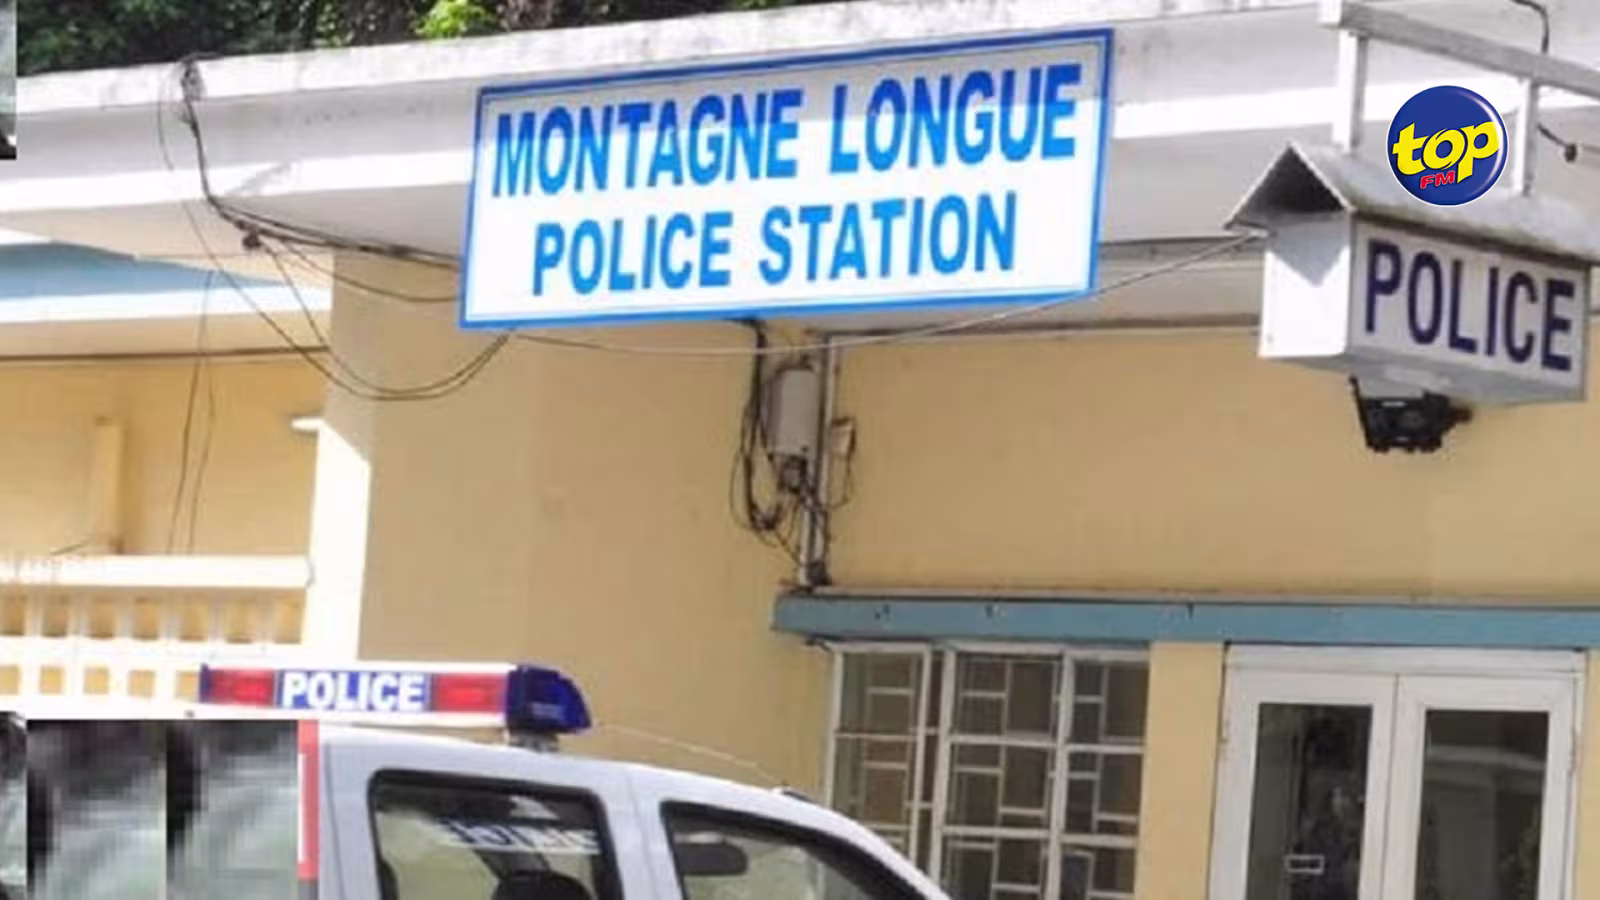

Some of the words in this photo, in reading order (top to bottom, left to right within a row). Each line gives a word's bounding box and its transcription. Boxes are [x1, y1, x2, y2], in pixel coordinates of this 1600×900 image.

[493, 89, 803, 197] MONTAGNE
[830, 64, 1081, 172] LONGUE
[534, 211, 732, 295] POLICE
[759, 191, 1017, 284] STATION
[1365, 238, 1575, 371] POLICE
[282, 671, 426, 711] POLICE
